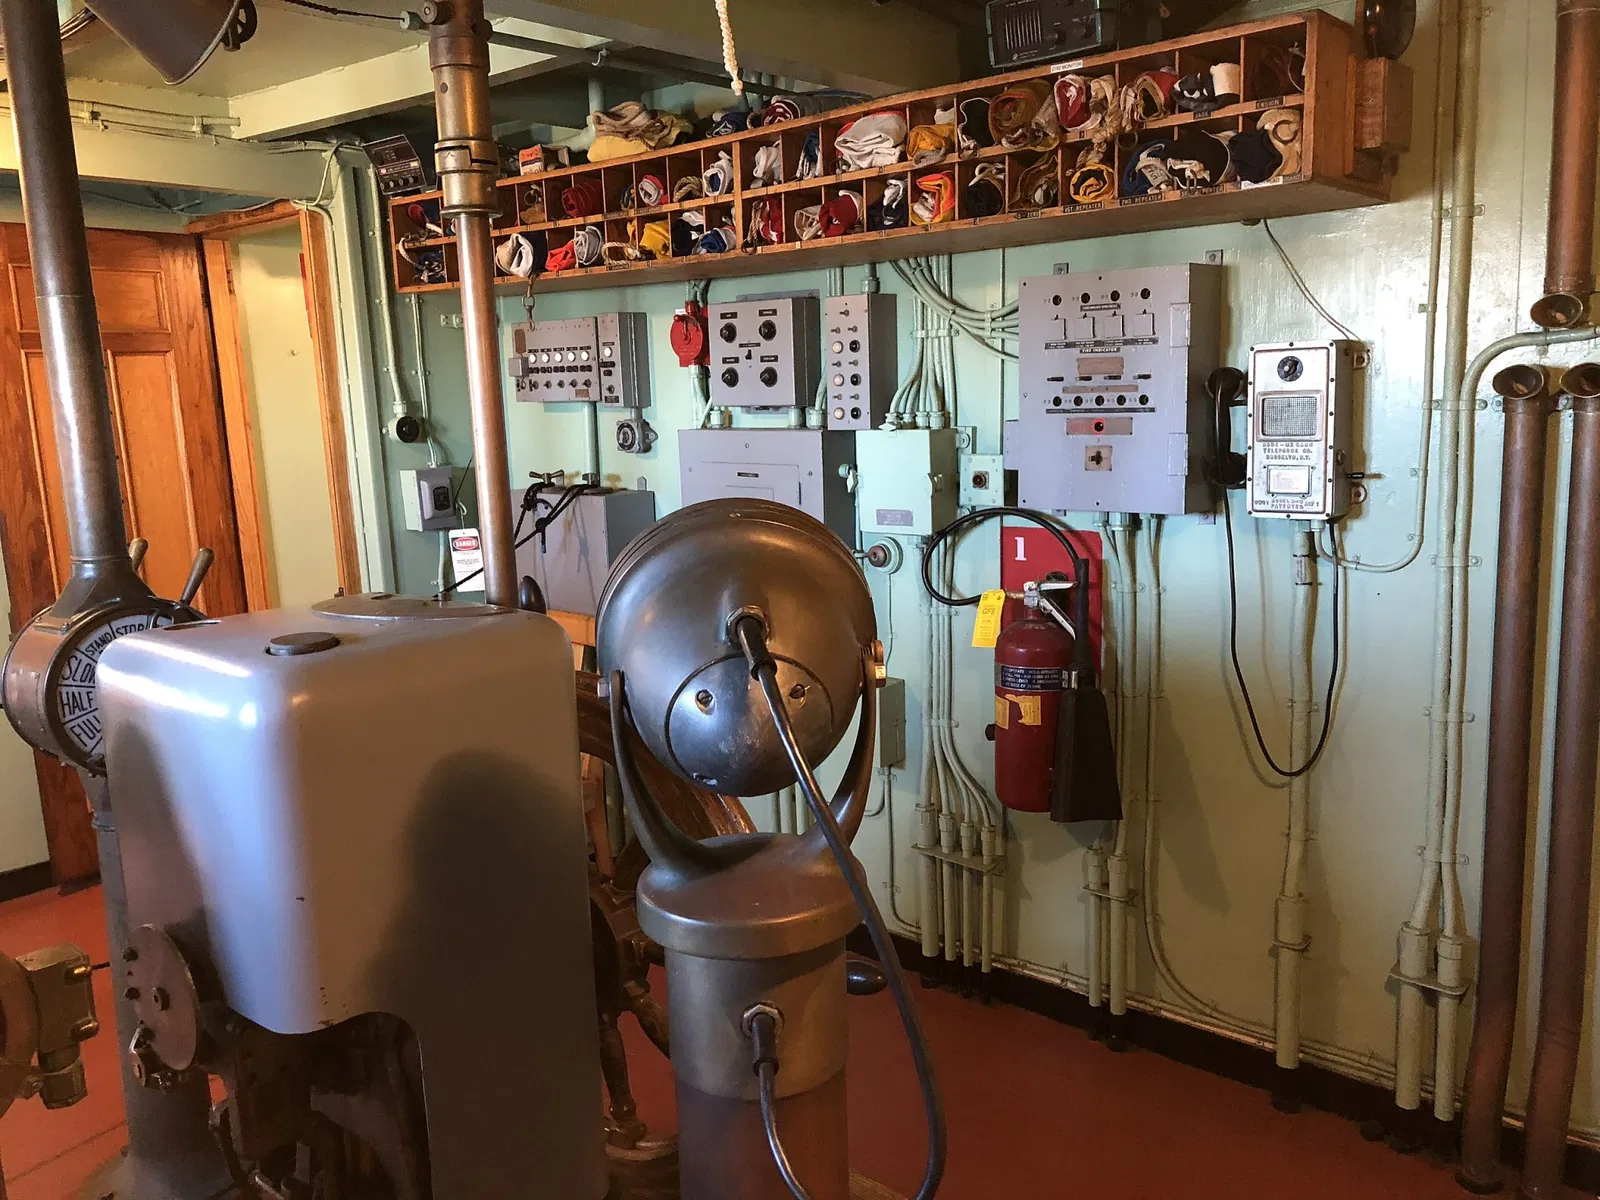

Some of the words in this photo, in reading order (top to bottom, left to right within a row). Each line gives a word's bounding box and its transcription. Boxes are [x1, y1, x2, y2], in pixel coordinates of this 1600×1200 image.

[1062, 61, 1082, 70] MONITOR
[1257, 99, 1280, 109] ENSIGN
[1134, 195, 1162, 204] REPEATER
[1076, 203, 1102, 212] REPEATER
[1026, 210, 1040, 218] ZERO
[456, 539, 476, 547] DANGER
[1014, 537, 1027, 560] 1
[981, 607, 996, 615] GFS
[85, 632, 113, 657] STAND
[59, 691, 94, 718] HALF
